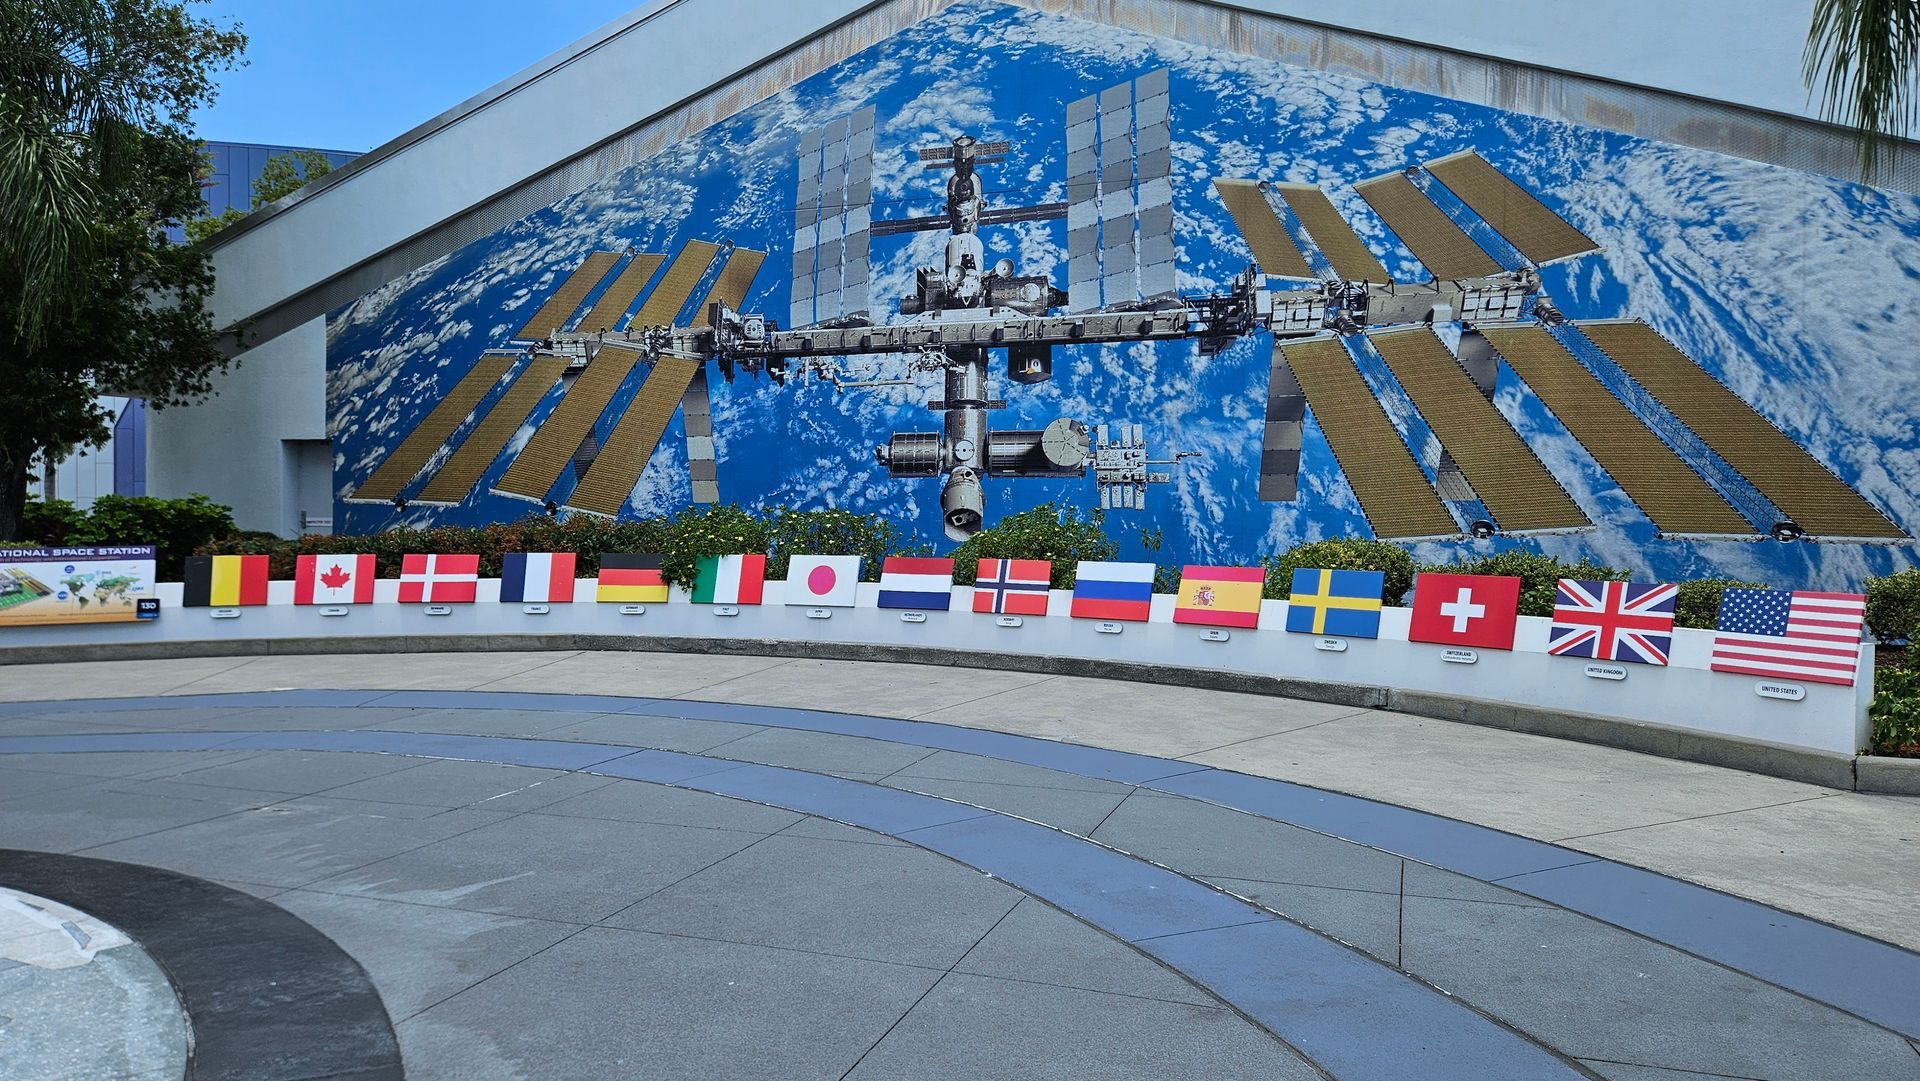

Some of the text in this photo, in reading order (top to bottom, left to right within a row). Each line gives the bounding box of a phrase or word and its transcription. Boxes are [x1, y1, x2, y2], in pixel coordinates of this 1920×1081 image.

[0, 547, 151, 557] TIONAL SPACE STATION
